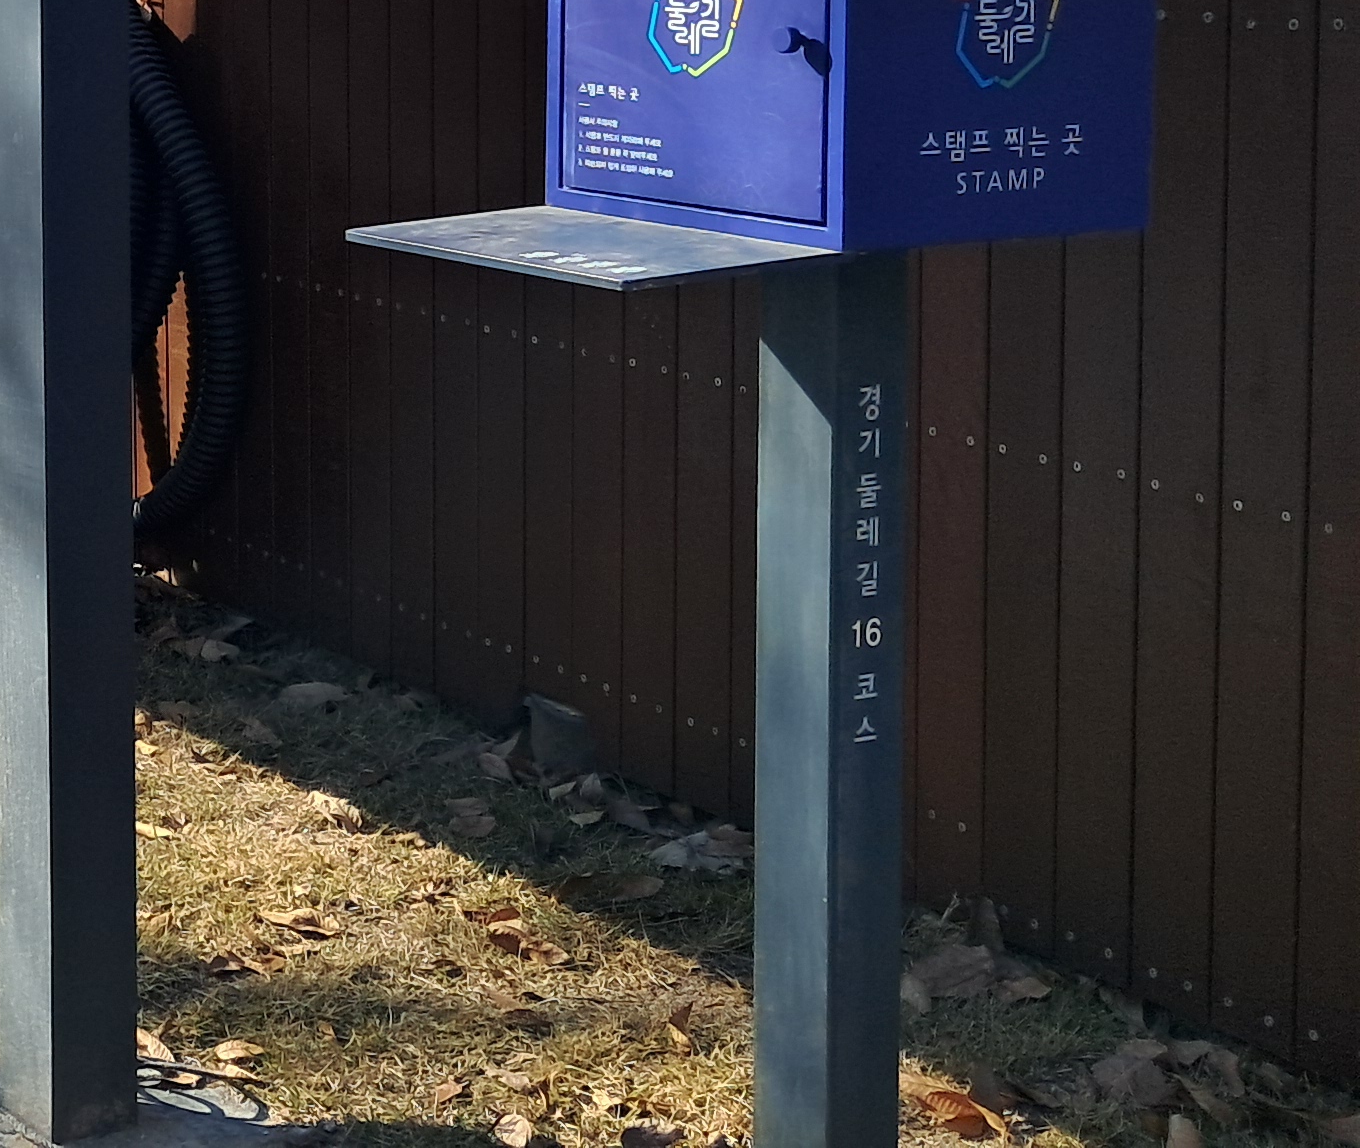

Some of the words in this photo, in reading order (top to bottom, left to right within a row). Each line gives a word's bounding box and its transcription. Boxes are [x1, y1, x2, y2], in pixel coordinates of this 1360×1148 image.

[920, 129, 991, 162] 스탬프
[1003, 126, 1050, 158] 찍는
[1061, 124, 1083, 156] 곳
[955, 167, 1046, 195] STAMP
[856, 383, 882, 597] 경기둘레길
